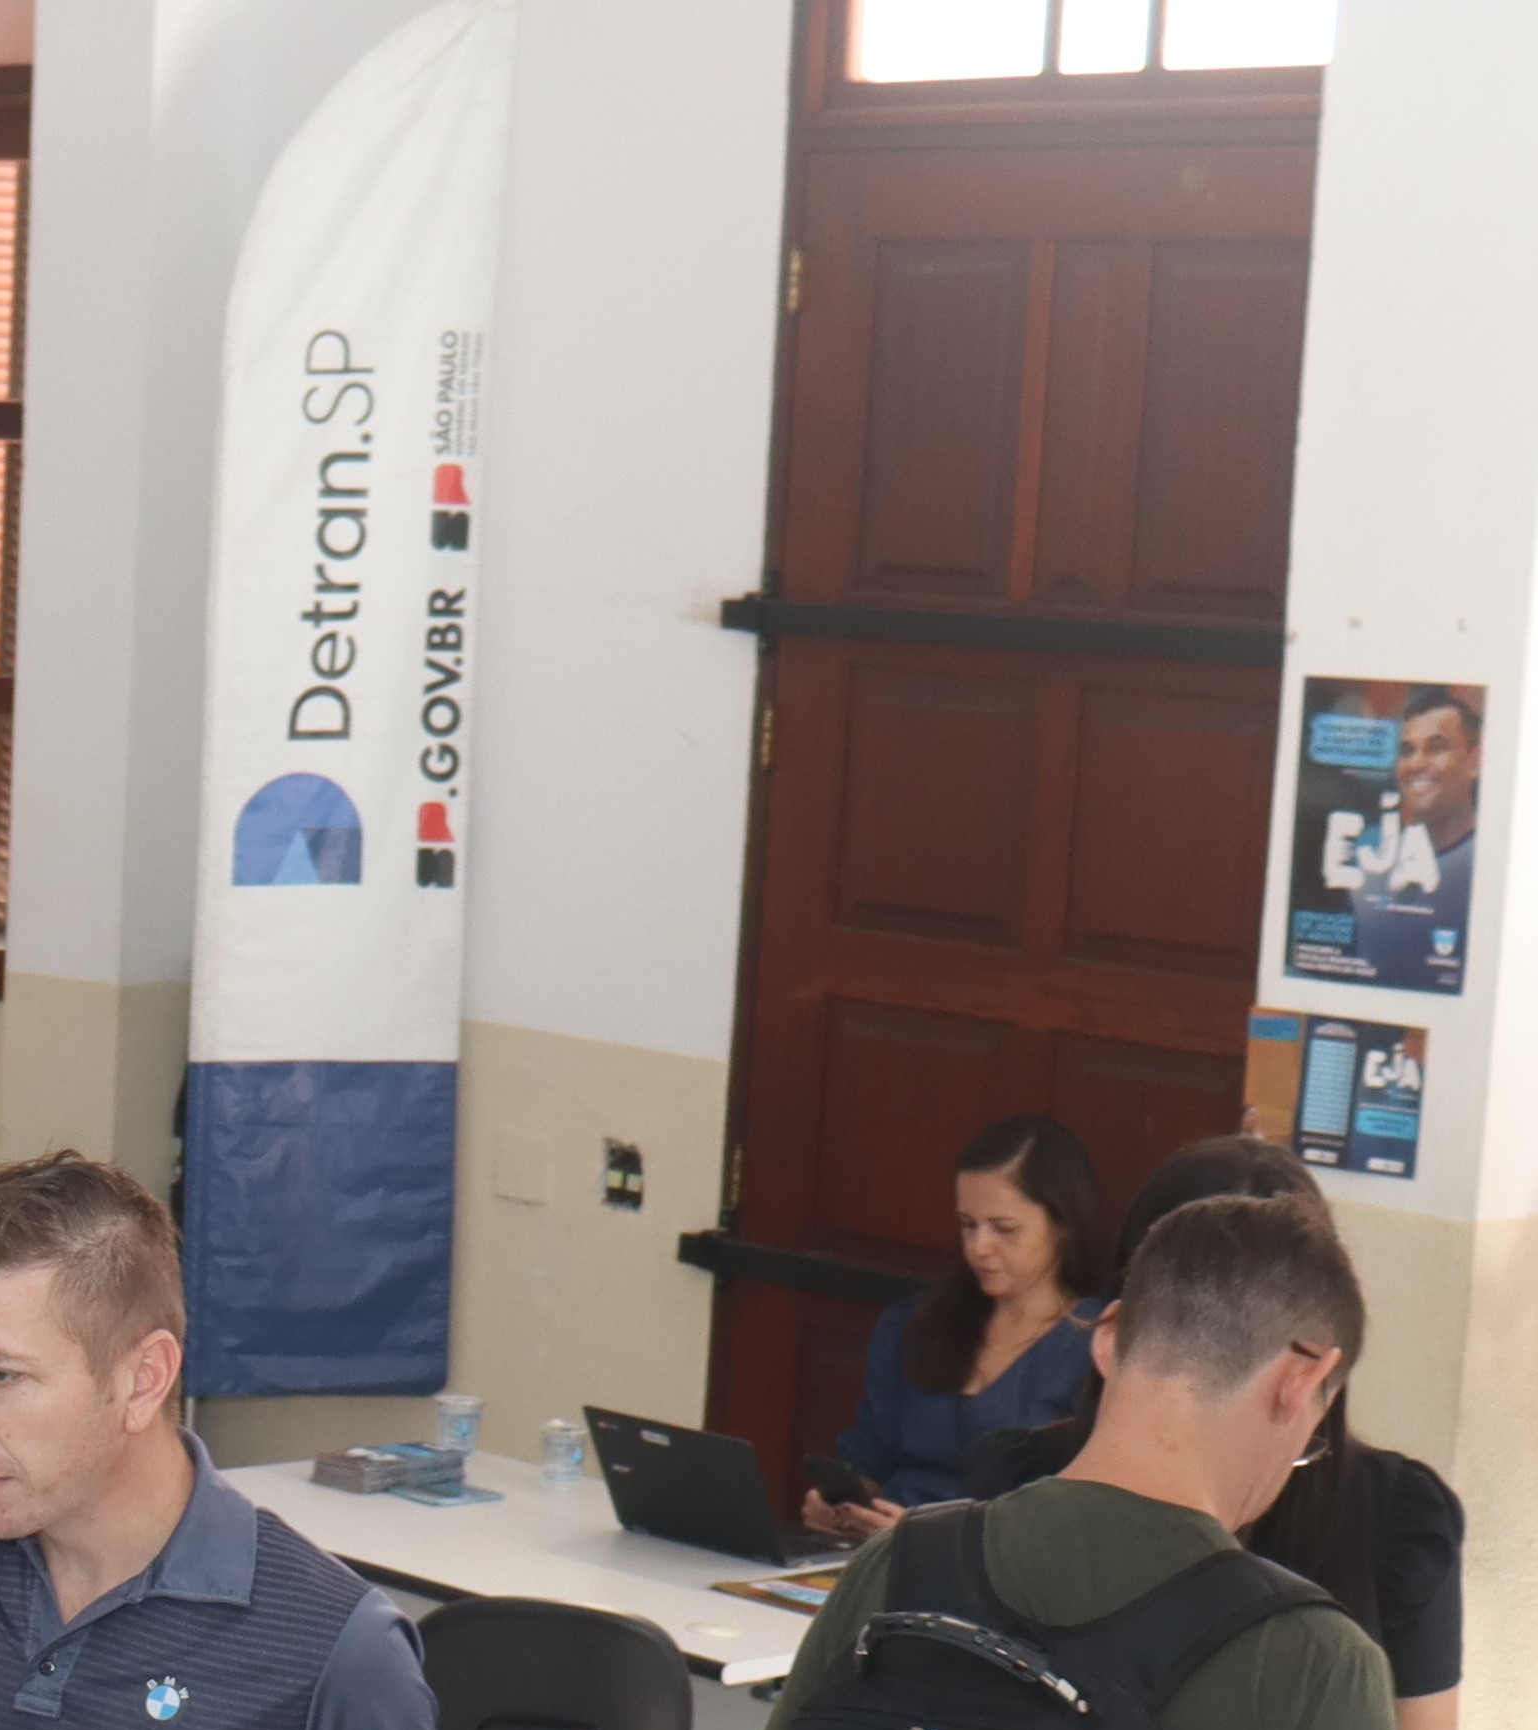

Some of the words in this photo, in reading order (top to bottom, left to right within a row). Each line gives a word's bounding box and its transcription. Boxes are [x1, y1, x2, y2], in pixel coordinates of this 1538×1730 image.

[436, 330, 459, 403] PAULO
[431, 406, 453, 455] SÃO
[287, 329, 374, 741] Detran.SP
[146, 1675, 190, 1699] BMW
